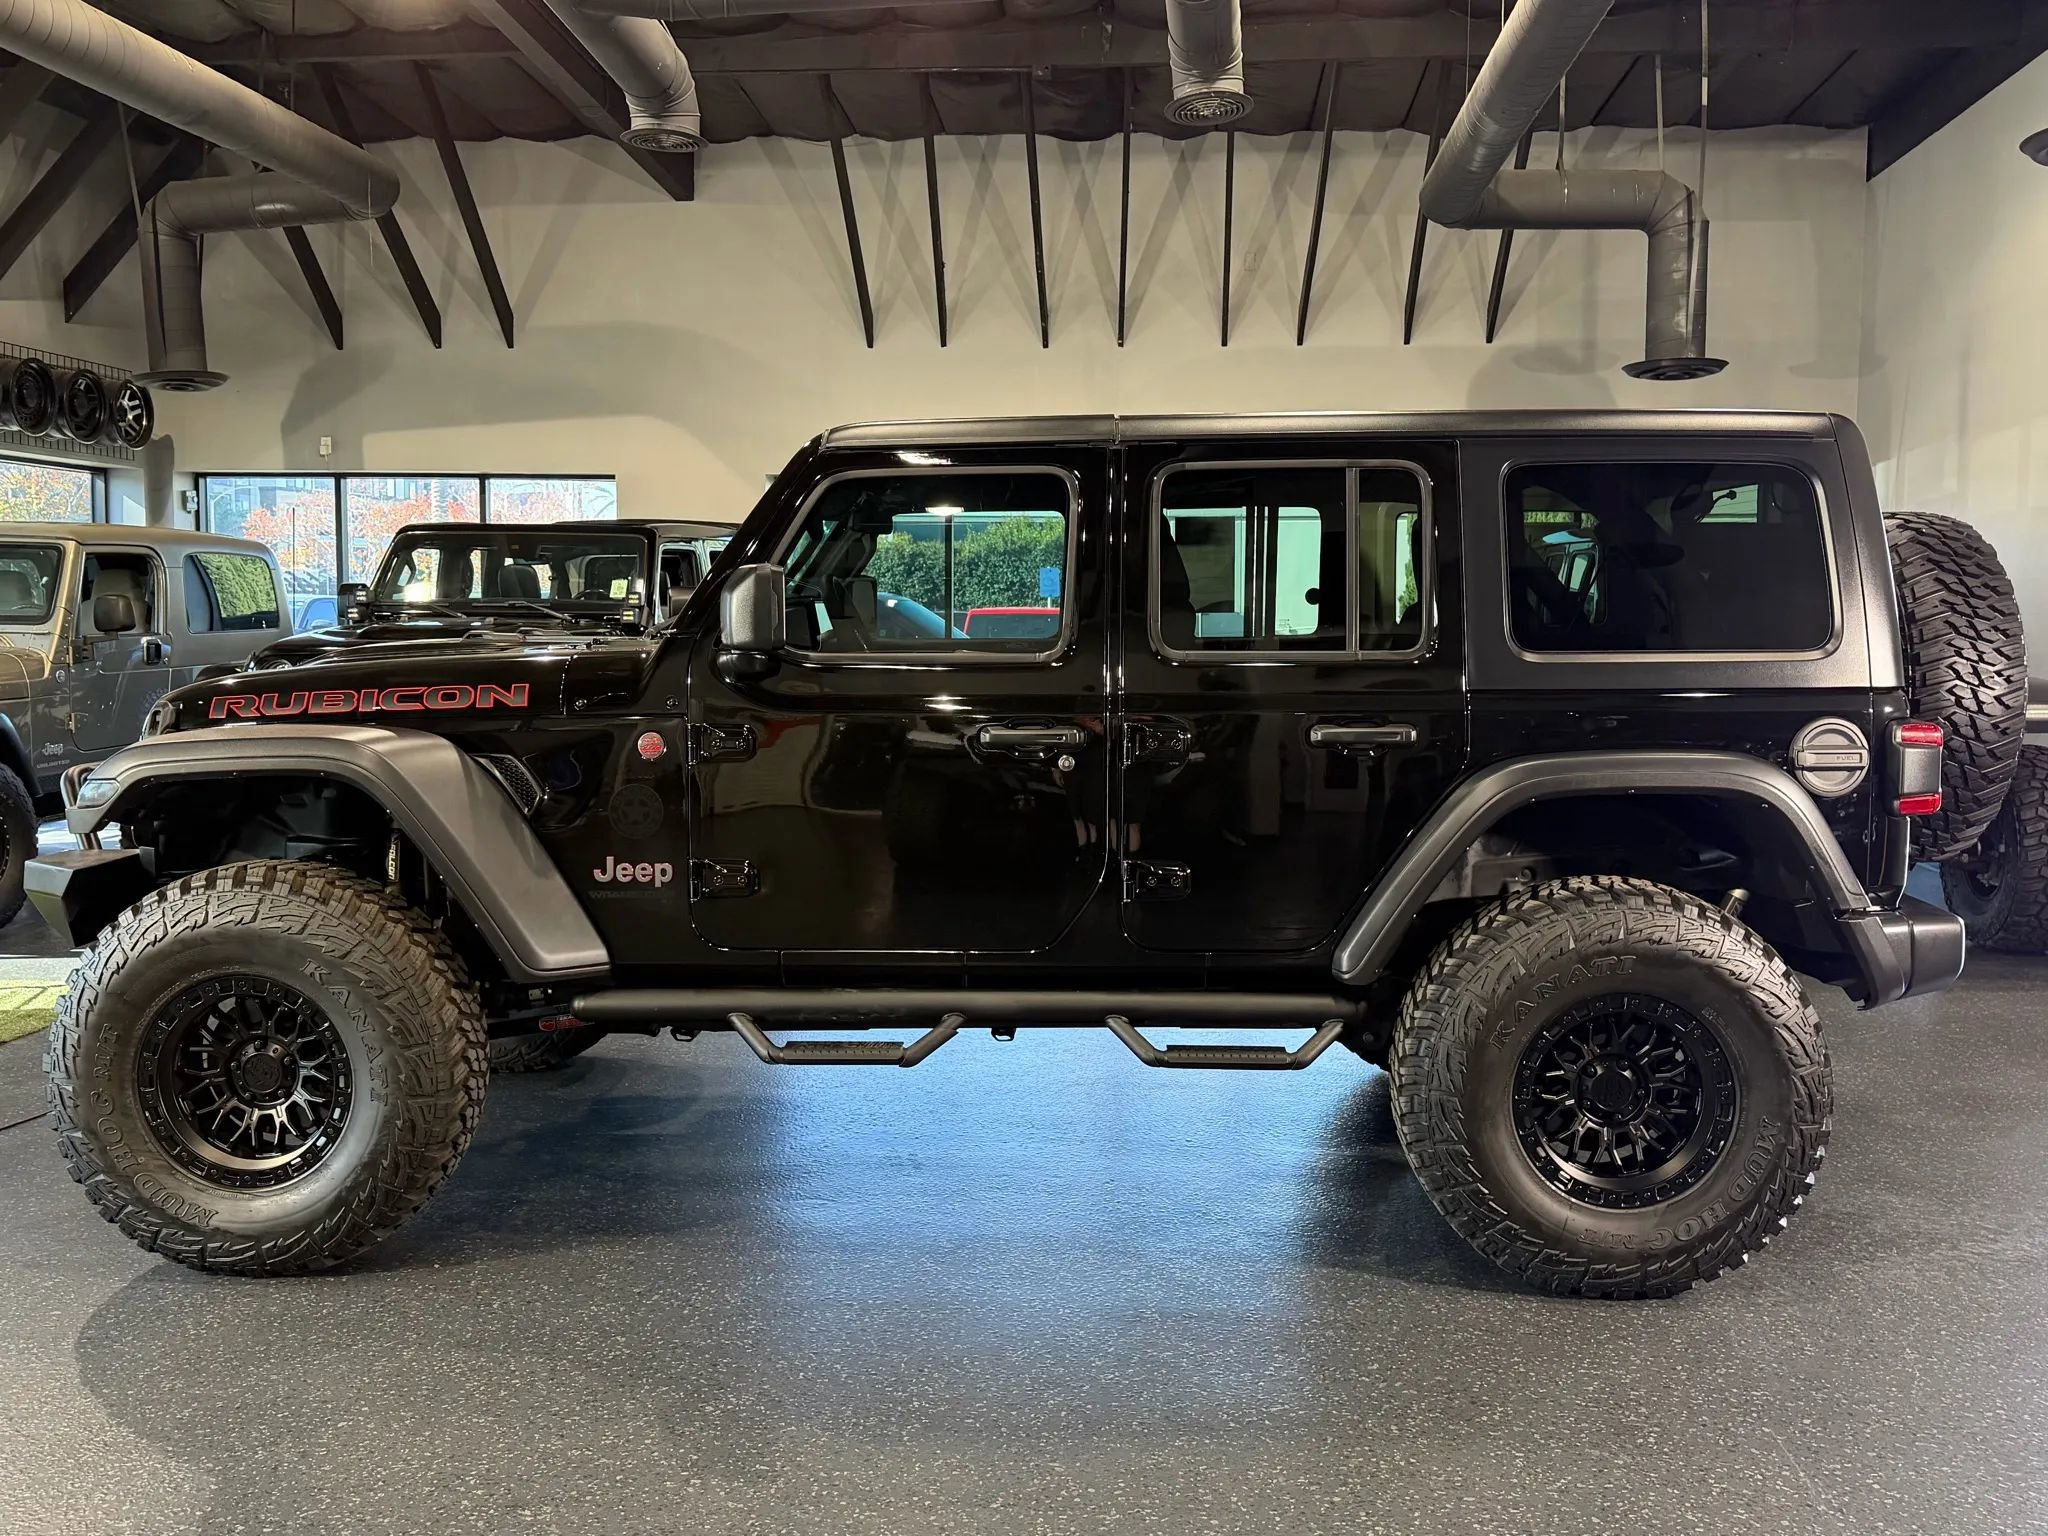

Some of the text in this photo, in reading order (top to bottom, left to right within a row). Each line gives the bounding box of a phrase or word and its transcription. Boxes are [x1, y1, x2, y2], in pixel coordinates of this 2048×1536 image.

[208, 683, 530, 719] RUBICON
[42, 742, 64, 756] Jeep
[593, 856, 673, 888] Jeep
[1489, 955, 1638, 1050] KANATI
[299, 958, 389, 1107] KANATI
[90, 1087, 141, 1171] HOG
[1727, 1115, 1781, 1201] MUD
[133, 1171, 220, 1228] MUD
[1649, 1200, 1731, 1250] HOG
